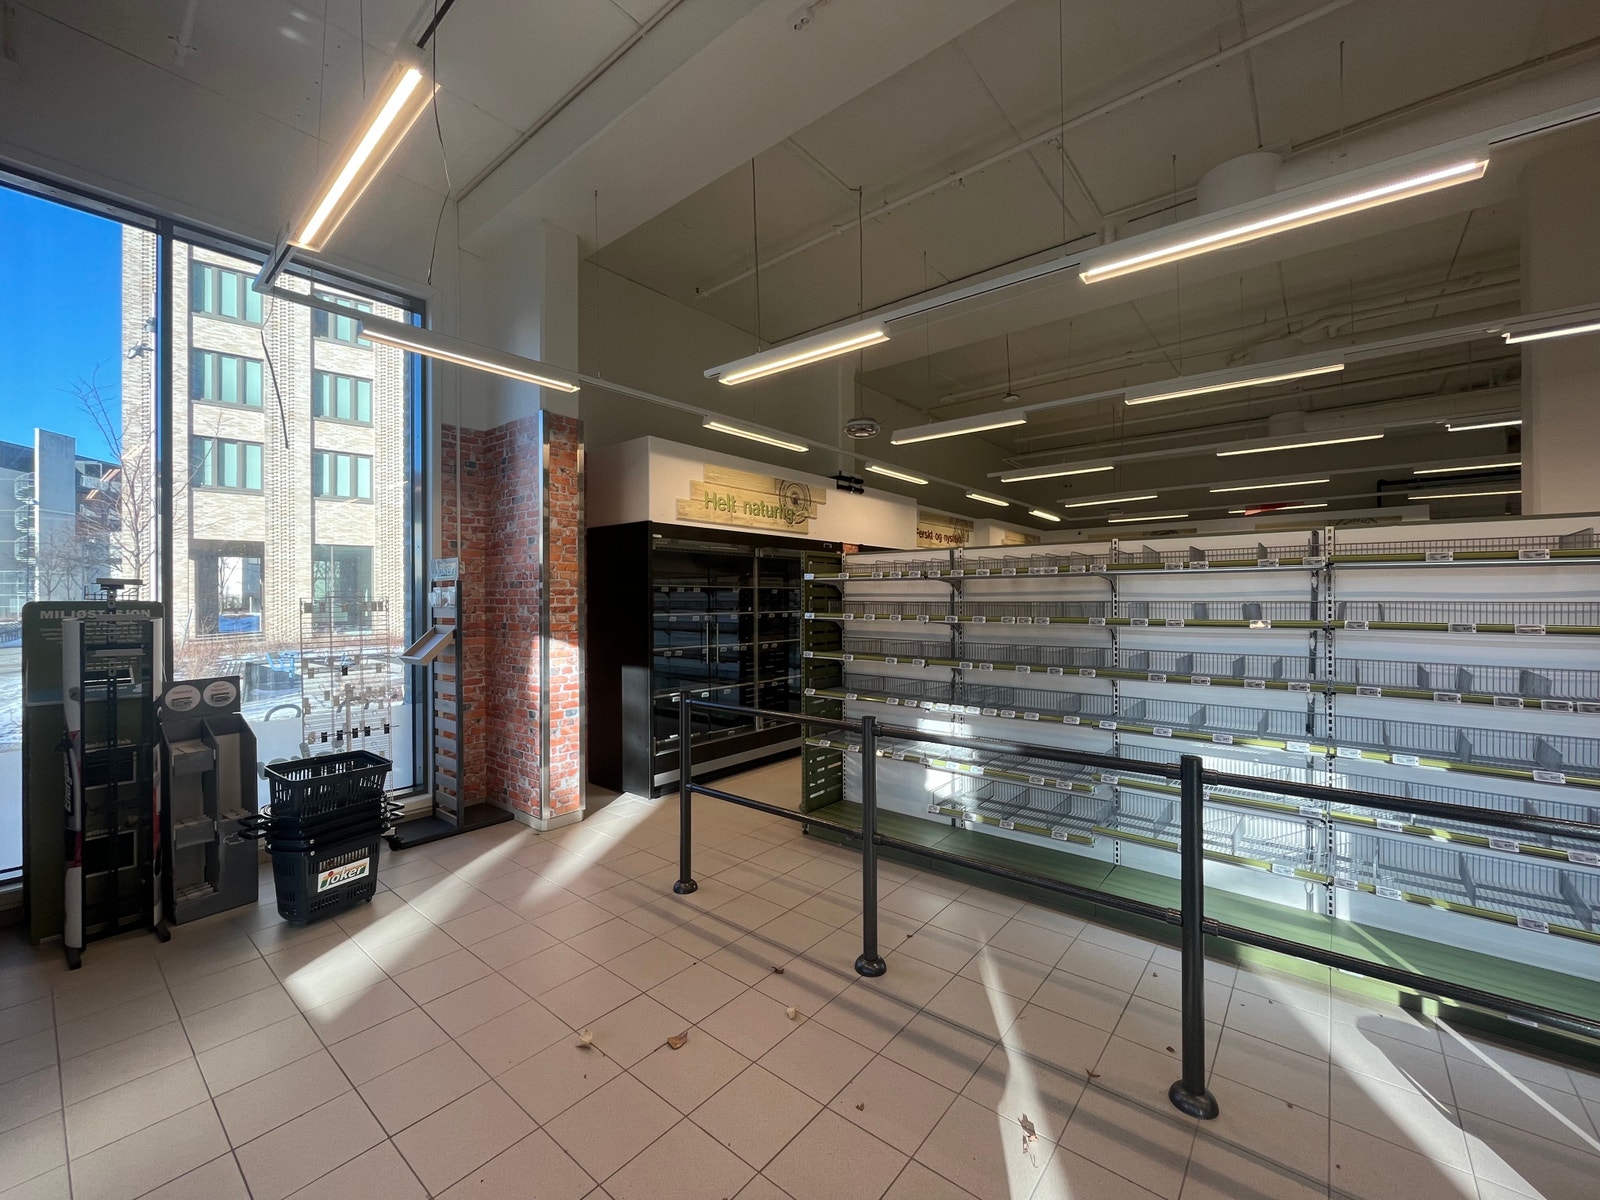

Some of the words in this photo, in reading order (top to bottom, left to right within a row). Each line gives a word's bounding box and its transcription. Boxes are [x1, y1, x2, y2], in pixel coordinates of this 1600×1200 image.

[704, 491, 737, 514] Helt
[743, 500, 796, 524] naturlig
[934, 532, 942, 544] og
[40, 609, 151, 620] MILJØSTSJON
[320, 865, 366, 889] joker
